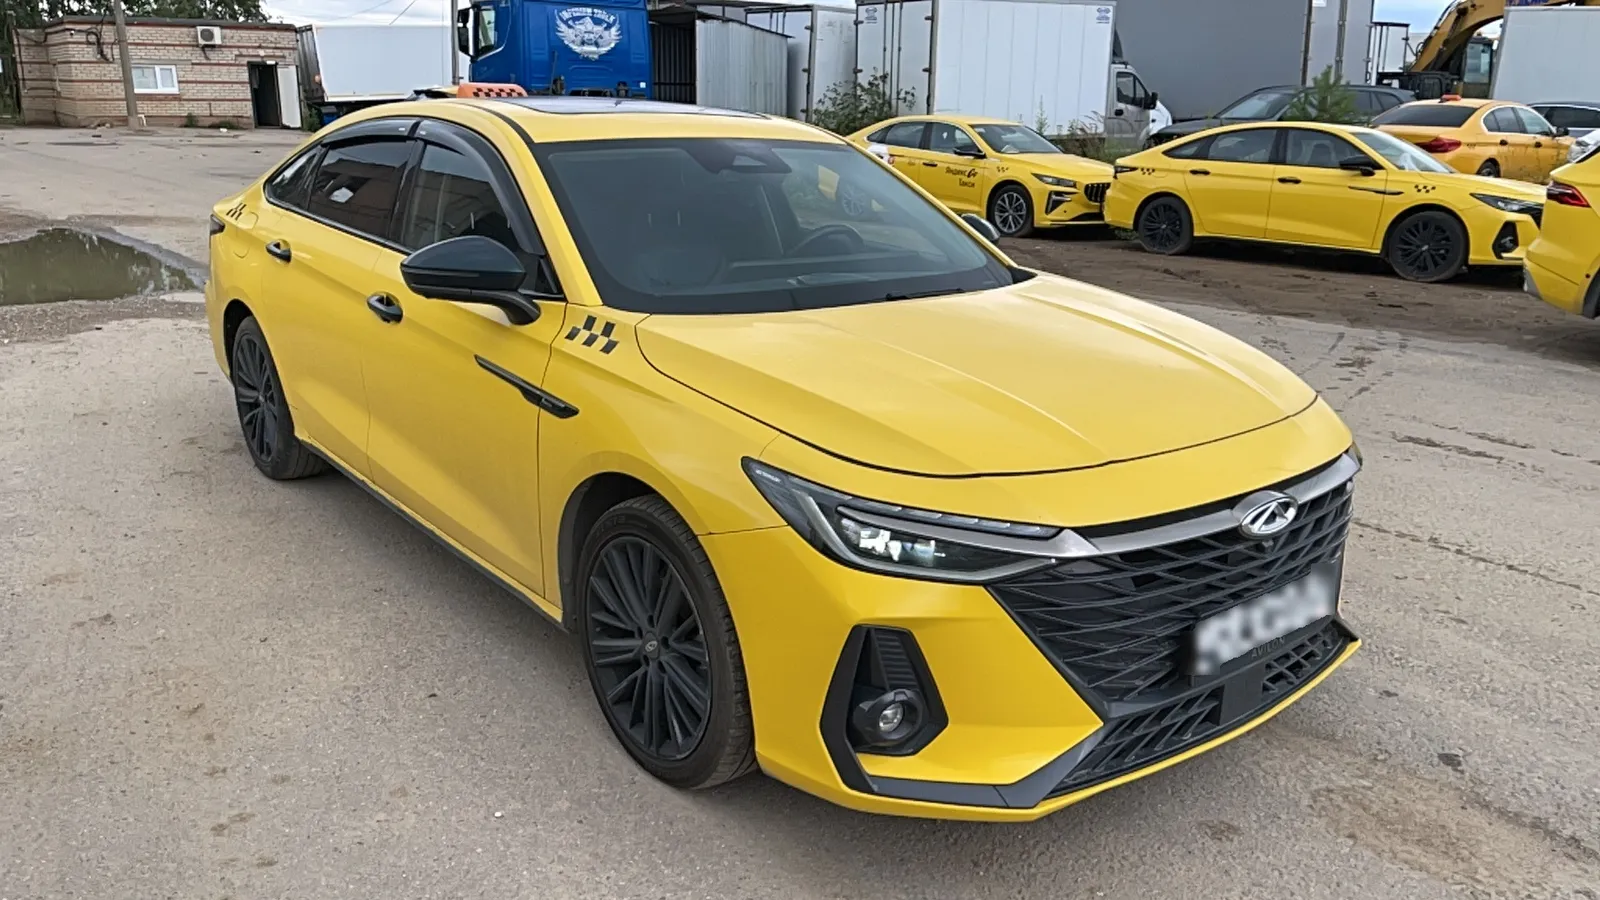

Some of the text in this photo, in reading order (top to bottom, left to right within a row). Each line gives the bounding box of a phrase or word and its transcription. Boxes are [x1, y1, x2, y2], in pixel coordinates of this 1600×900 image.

[945, 166, 967, 176] Яндекс
[958, 178, 975, 188] Такси
[1251, 636, 1285, 659] AVILON
